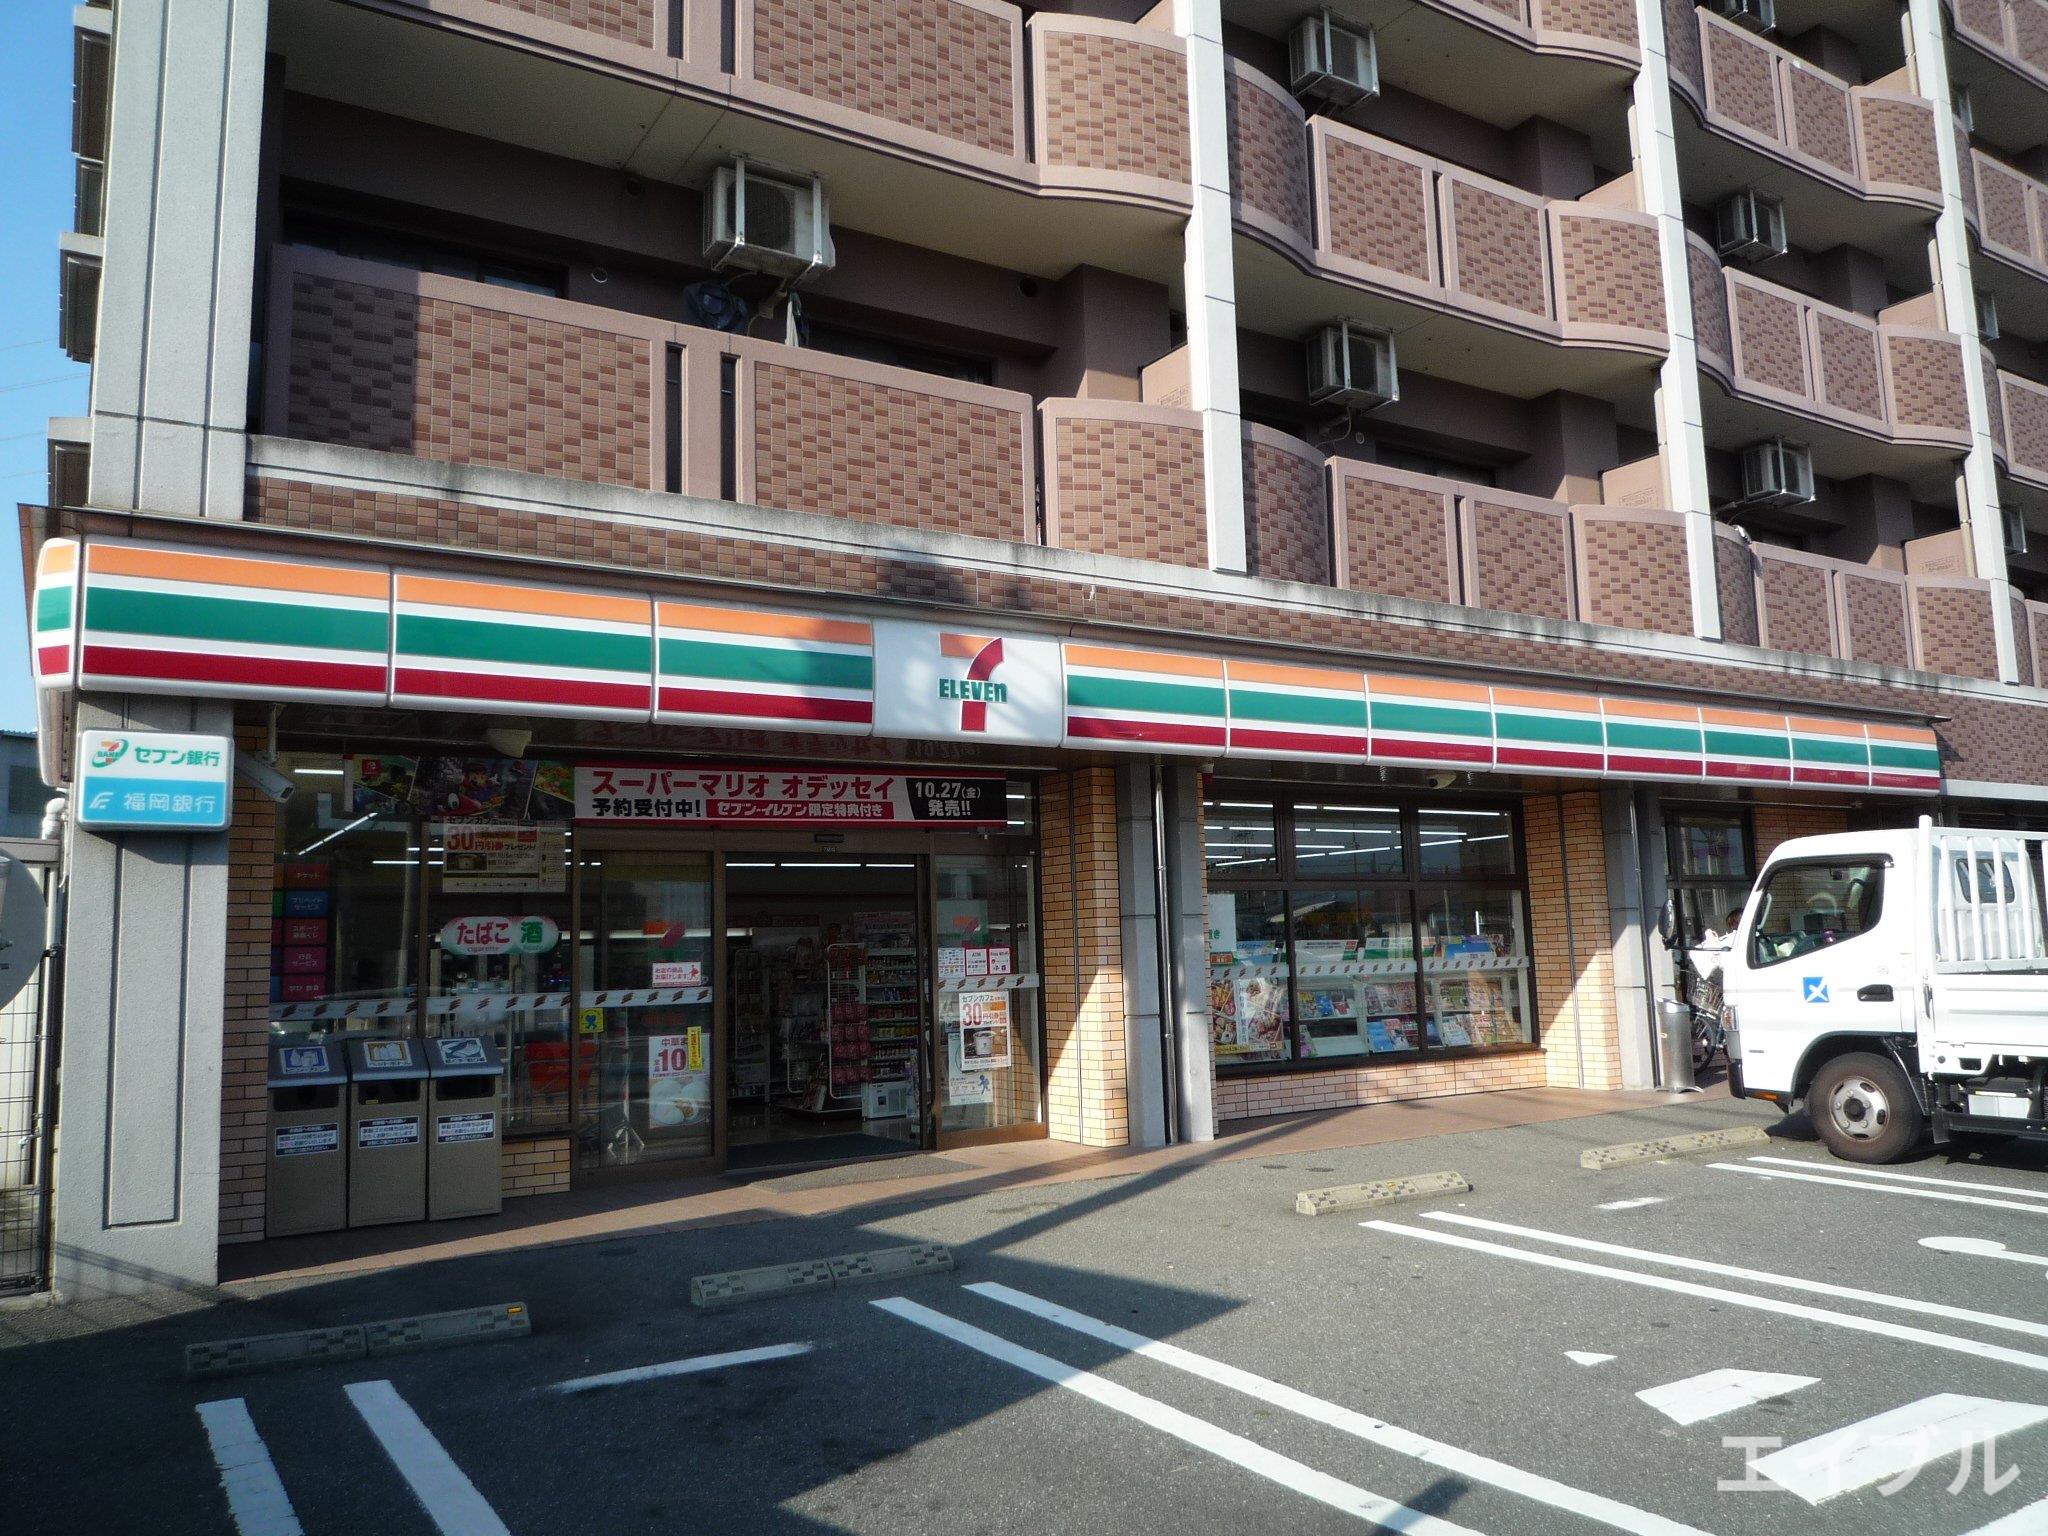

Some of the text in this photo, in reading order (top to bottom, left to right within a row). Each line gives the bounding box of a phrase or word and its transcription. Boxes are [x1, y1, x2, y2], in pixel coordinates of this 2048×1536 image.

[134, 746, 220, 767] セブン銀行
[592, 771, 895, 800] スーパーマリオ オデッセイ
[914, 782, 981, 799] 10.27(金)
[124, 792, 216, 813] 福岡銀行
[592, 798, 700, 818] 予約受付中!
[447, 826, 475, 851] 30
[457, 921, 543, 945] たばこ 酒
[963, 1003, 982, 1026] 30
